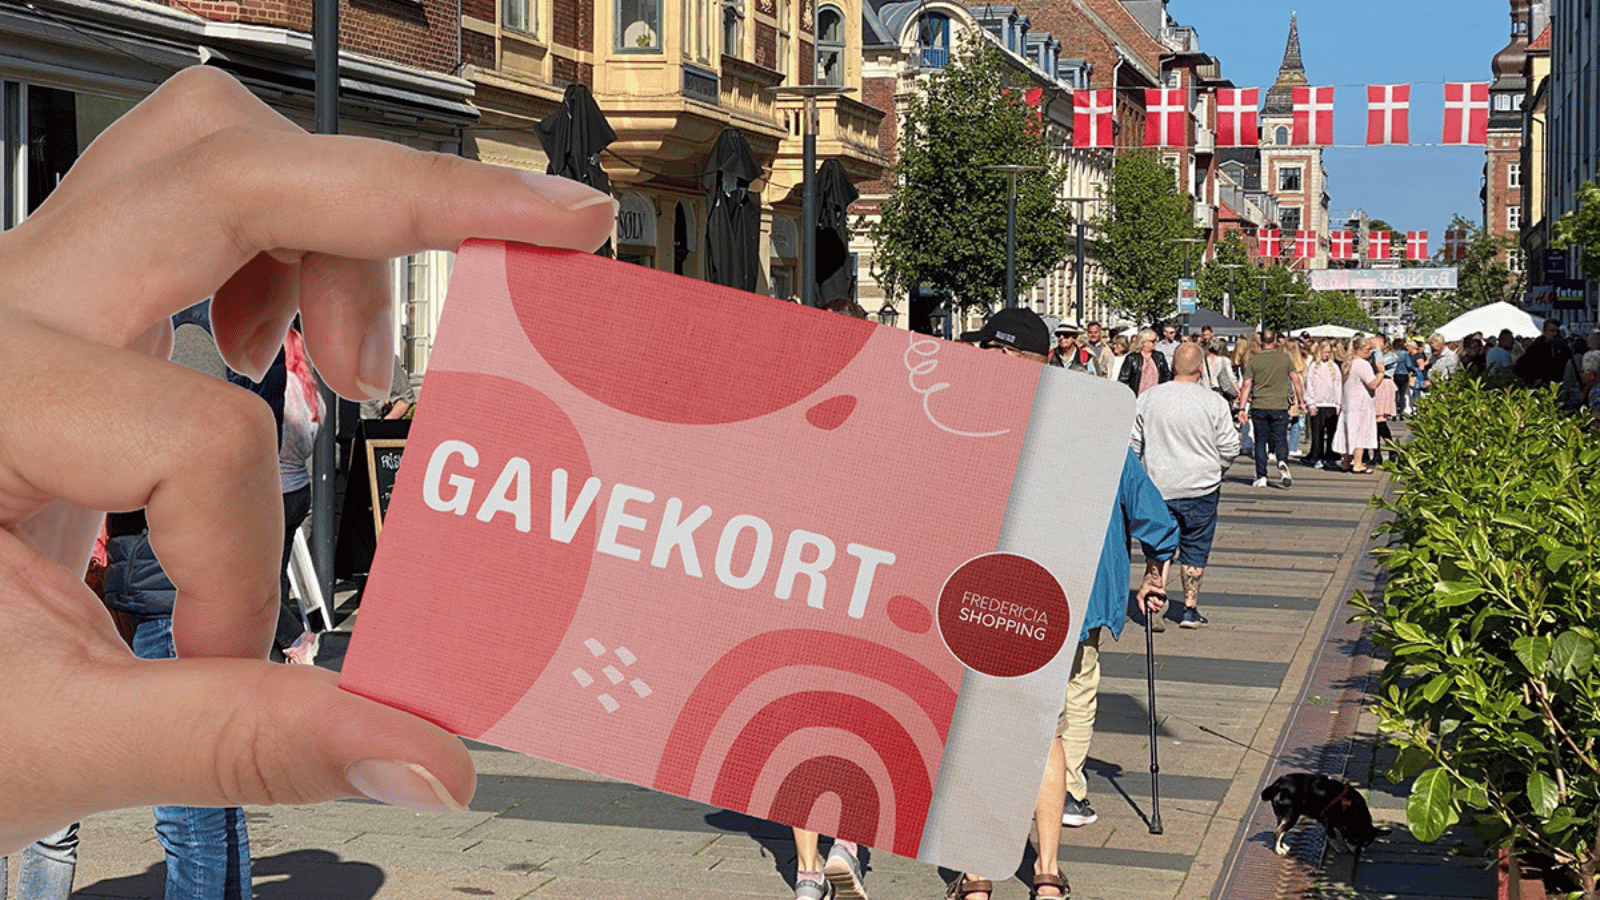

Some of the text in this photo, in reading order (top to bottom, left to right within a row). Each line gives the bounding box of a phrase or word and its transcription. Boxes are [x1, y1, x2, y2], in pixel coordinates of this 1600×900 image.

[422, 440, 896, 619] GAVEKORT
[958, 607, 1047, 641] SHOPPING
[962, 591, 1048, 625] FREDERICIA
